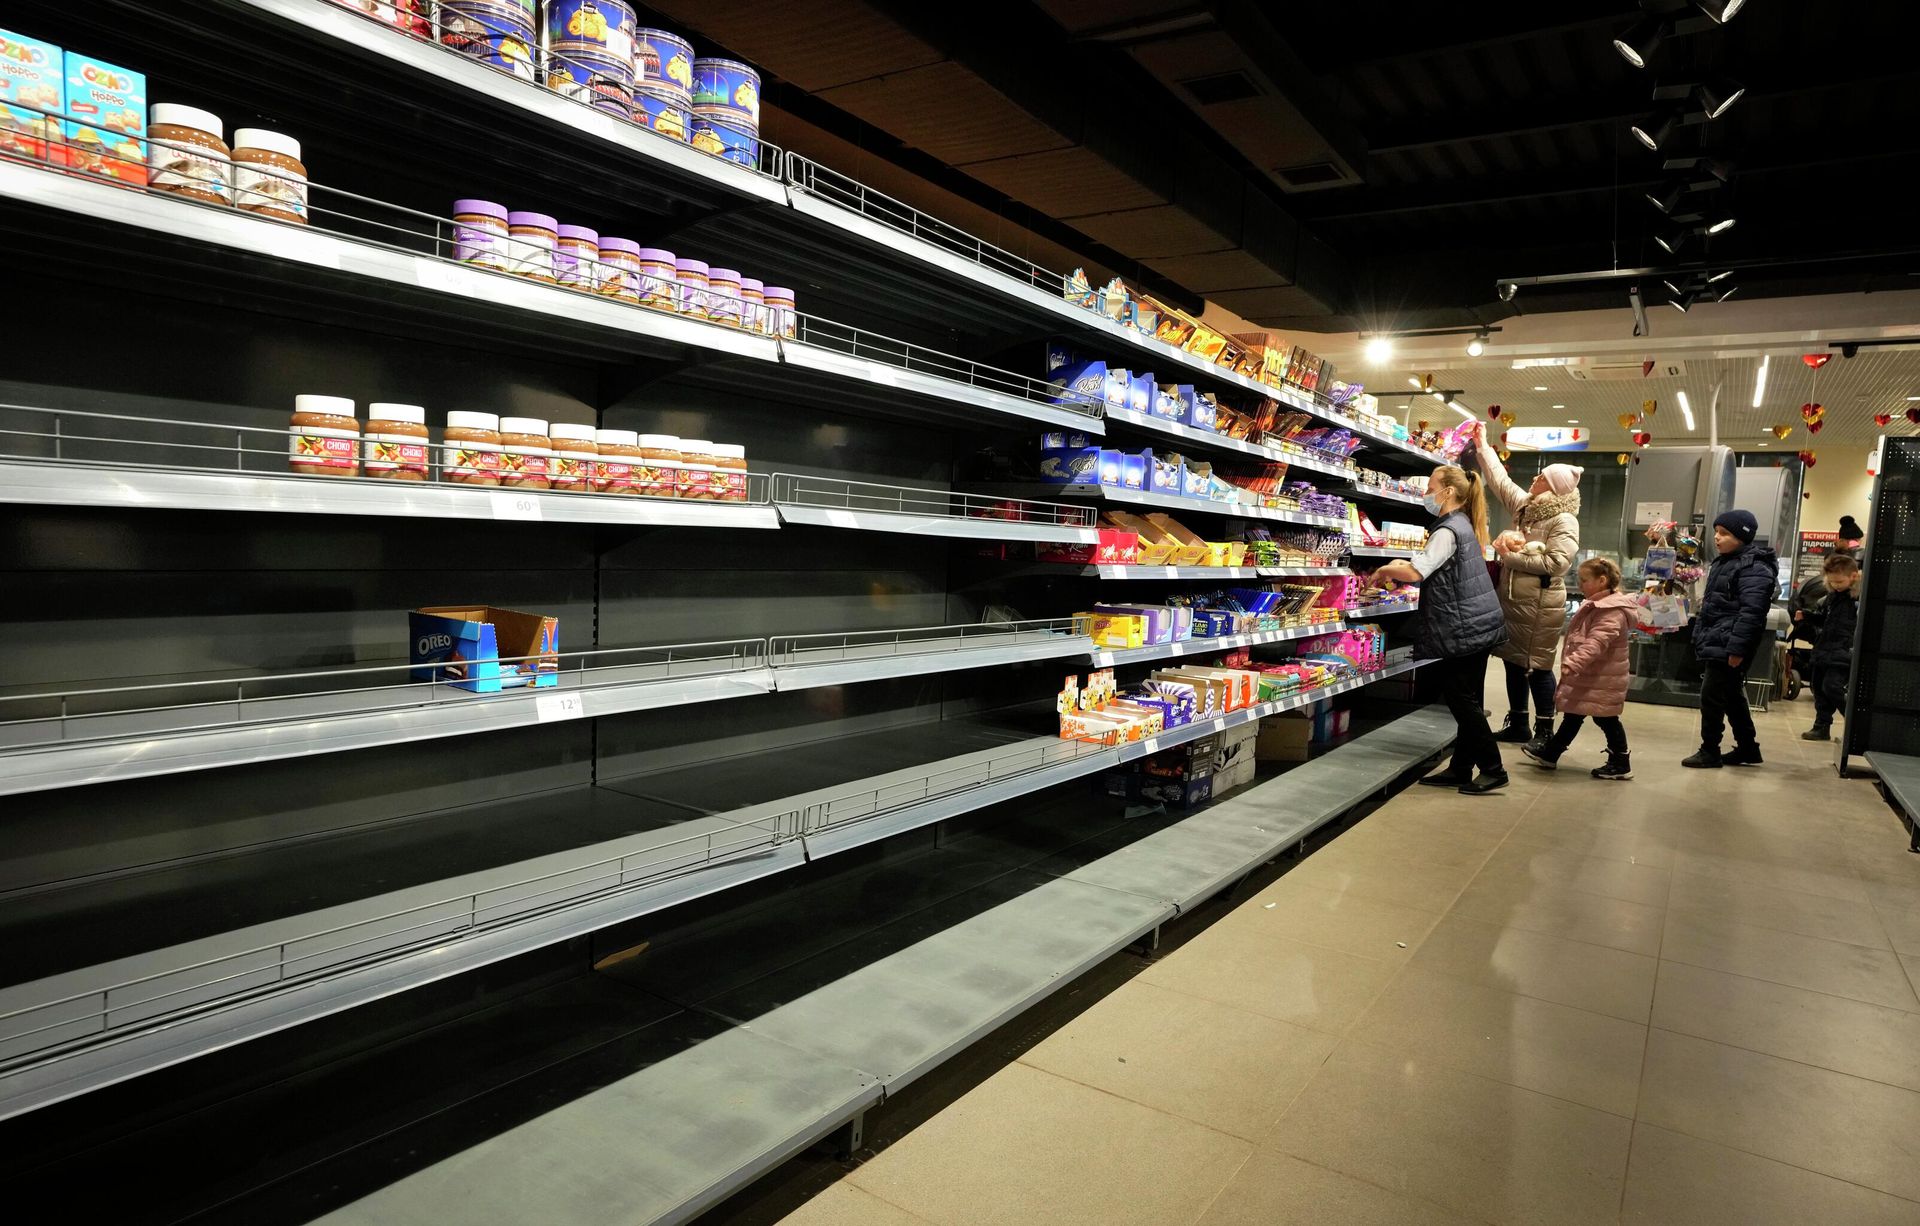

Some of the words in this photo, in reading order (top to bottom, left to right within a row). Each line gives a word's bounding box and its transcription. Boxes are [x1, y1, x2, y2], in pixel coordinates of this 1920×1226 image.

[326, 440, 350, 452] CHOKO
[402, 447, 422, 457] CHOKO
[525, 458, 545, 467] CHOKO
[608, 465, 628, 474] CHOKO
[516, 500, 531, 512] 60
[418, 634, 450, 655] OREO
[561, 699, 574, 710] 12
